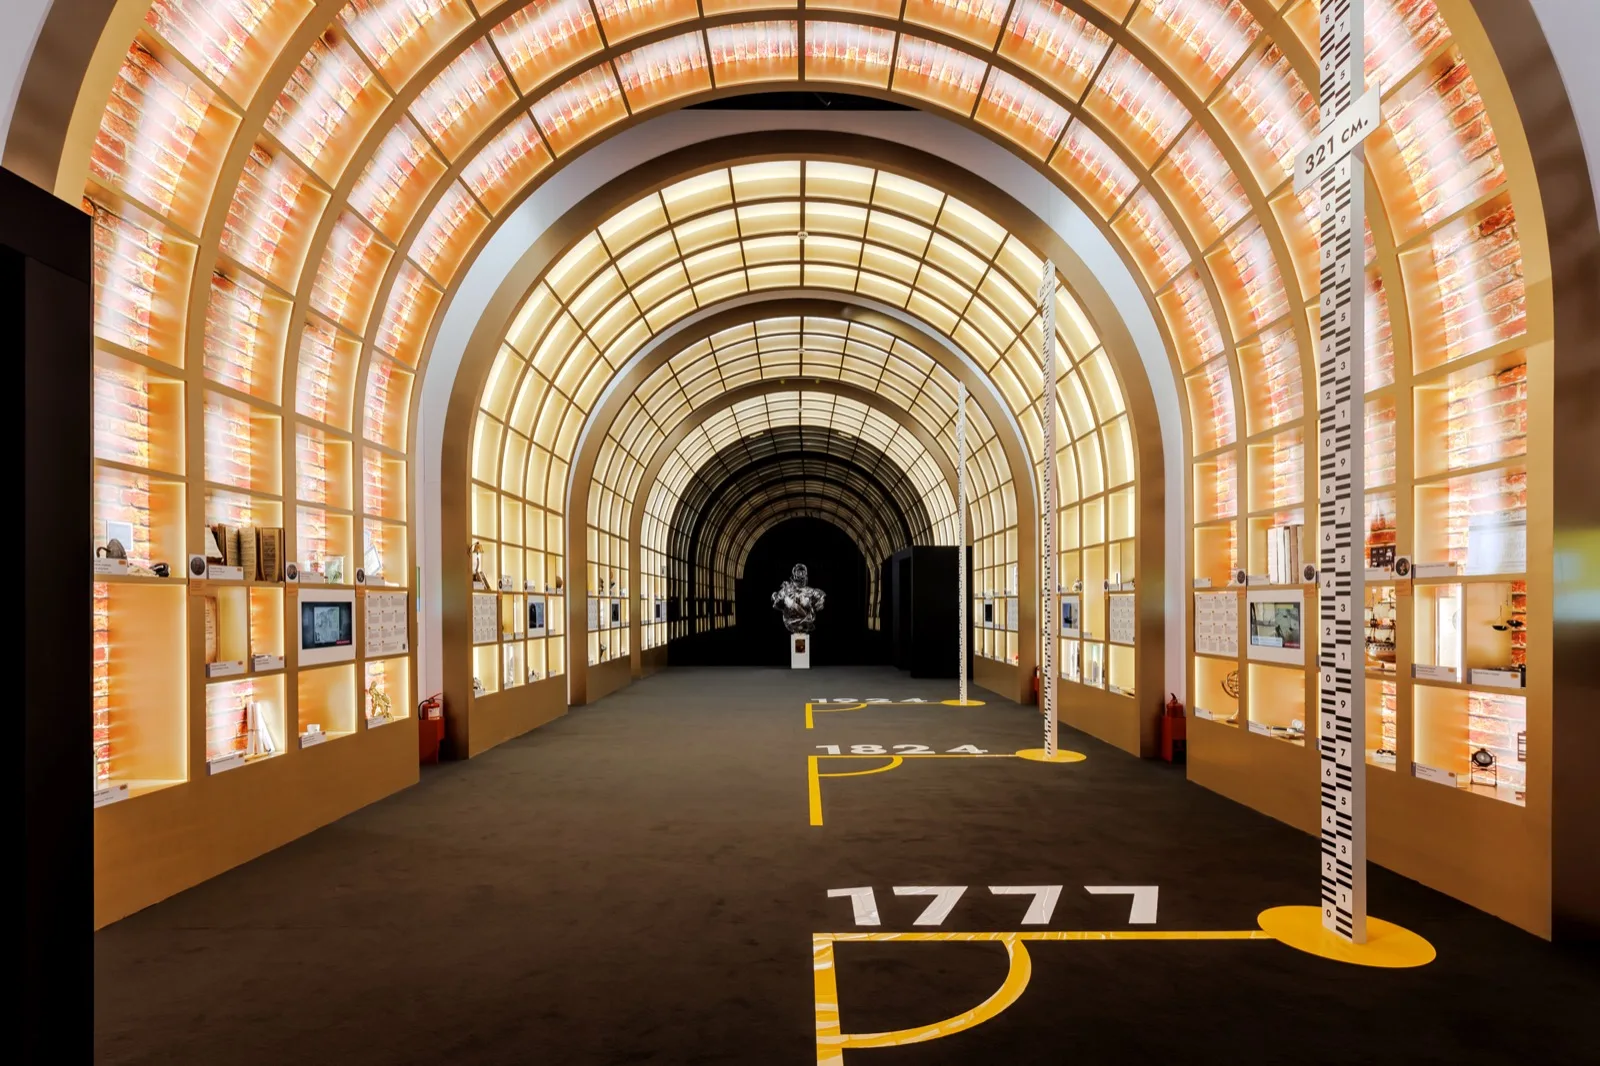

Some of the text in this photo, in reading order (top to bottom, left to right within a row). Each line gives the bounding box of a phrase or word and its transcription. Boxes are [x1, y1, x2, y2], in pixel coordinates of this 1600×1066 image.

[1305, 135, 1334, 175] 321
[1340, 167, 1345, 176] 1
[1325, 202, 1331, 212] 0
[1340, 215, 1347, 225] 9
[1325, 249, 1331, 259] 8
[1340, 263, 1346, 274] 7
[1325, 296, 1331, 307] 6
[1340, 311, 1346, 322] 5
[1325, 343, 1332, 353] 4
[1340, 360, 1346, 371] 3
[1325, 391, 1331, 401] 2
[1340, 409, 1346, 419] 1
[1325, 438, 1331, 448] 0
[1340, 457, 1346, 468] 9
[1325, 485, 1331, 495] 8
[1340, 506, 1346, 516] 7
[1325, 532, 1331, 542] 6
[1340, 554, 1346, 565] 5
[1325, 579, 1331, 589] 4
[1340, 603, 1346, 613] 3
[1325, 626, 1331, 636] 2
[1340, 651, 1346, 661] 1
[1325, 673, 1332, 684] 0
[1340, 699, 1347, 709] 9
[1325, 720, 1331, 730] 8
[815, 744, 989, 755] 1824
[1340, 747, 1346, 757] 7
[1325, 767, 1332, 777] 6
[1340, 796, 1347, 806] 5
[1325, 815, 1332, 825] 4
[1340, 844, 1347, 855] 3
[1326, 861, 1332, 872] 2
[1340, 893, 1346, 903] 1
[827, 885, 1159, 925] 1777
[1325, 908, 1332, 919] 0
